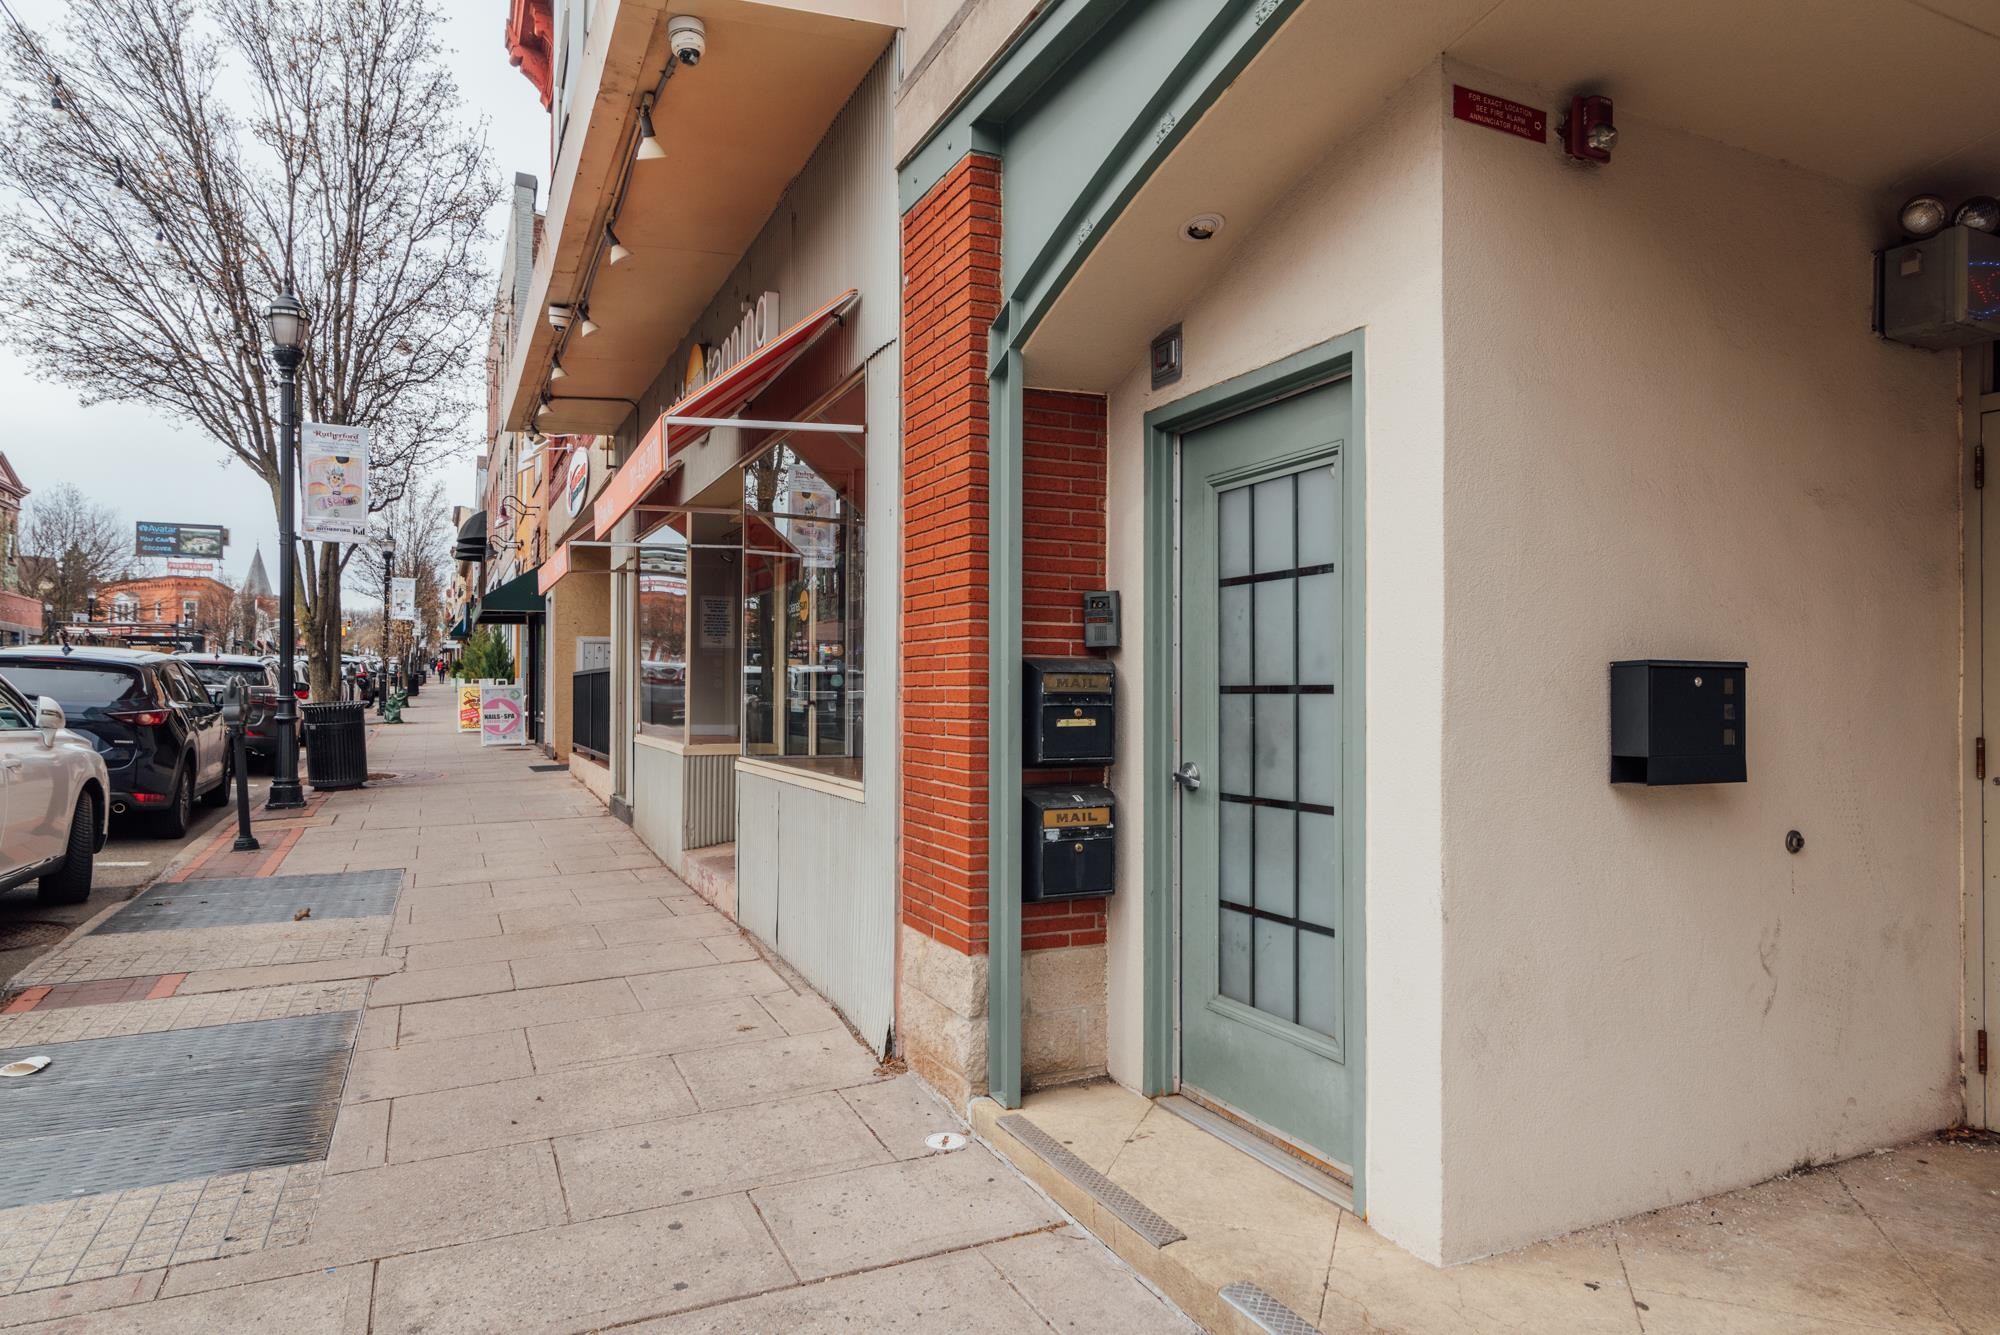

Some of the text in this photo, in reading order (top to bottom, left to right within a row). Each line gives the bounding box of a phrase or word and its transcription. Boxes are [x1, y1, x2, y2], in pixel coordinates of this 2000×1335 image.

[1468, 92, 1533, 118] FOR EXACT LOCATION
[1475, 104, 1526, 125] SEE FIRE ALARM
[1469, 112, 1532, 137] ANNUNCIATOR PANEL
[313, 430, 360, 440] Rutherford
[148, 525, 177, 534] Avatar
[1056, 678, 1099, 689] MAIL
[1056, 812, 1098, 823] MAIL
